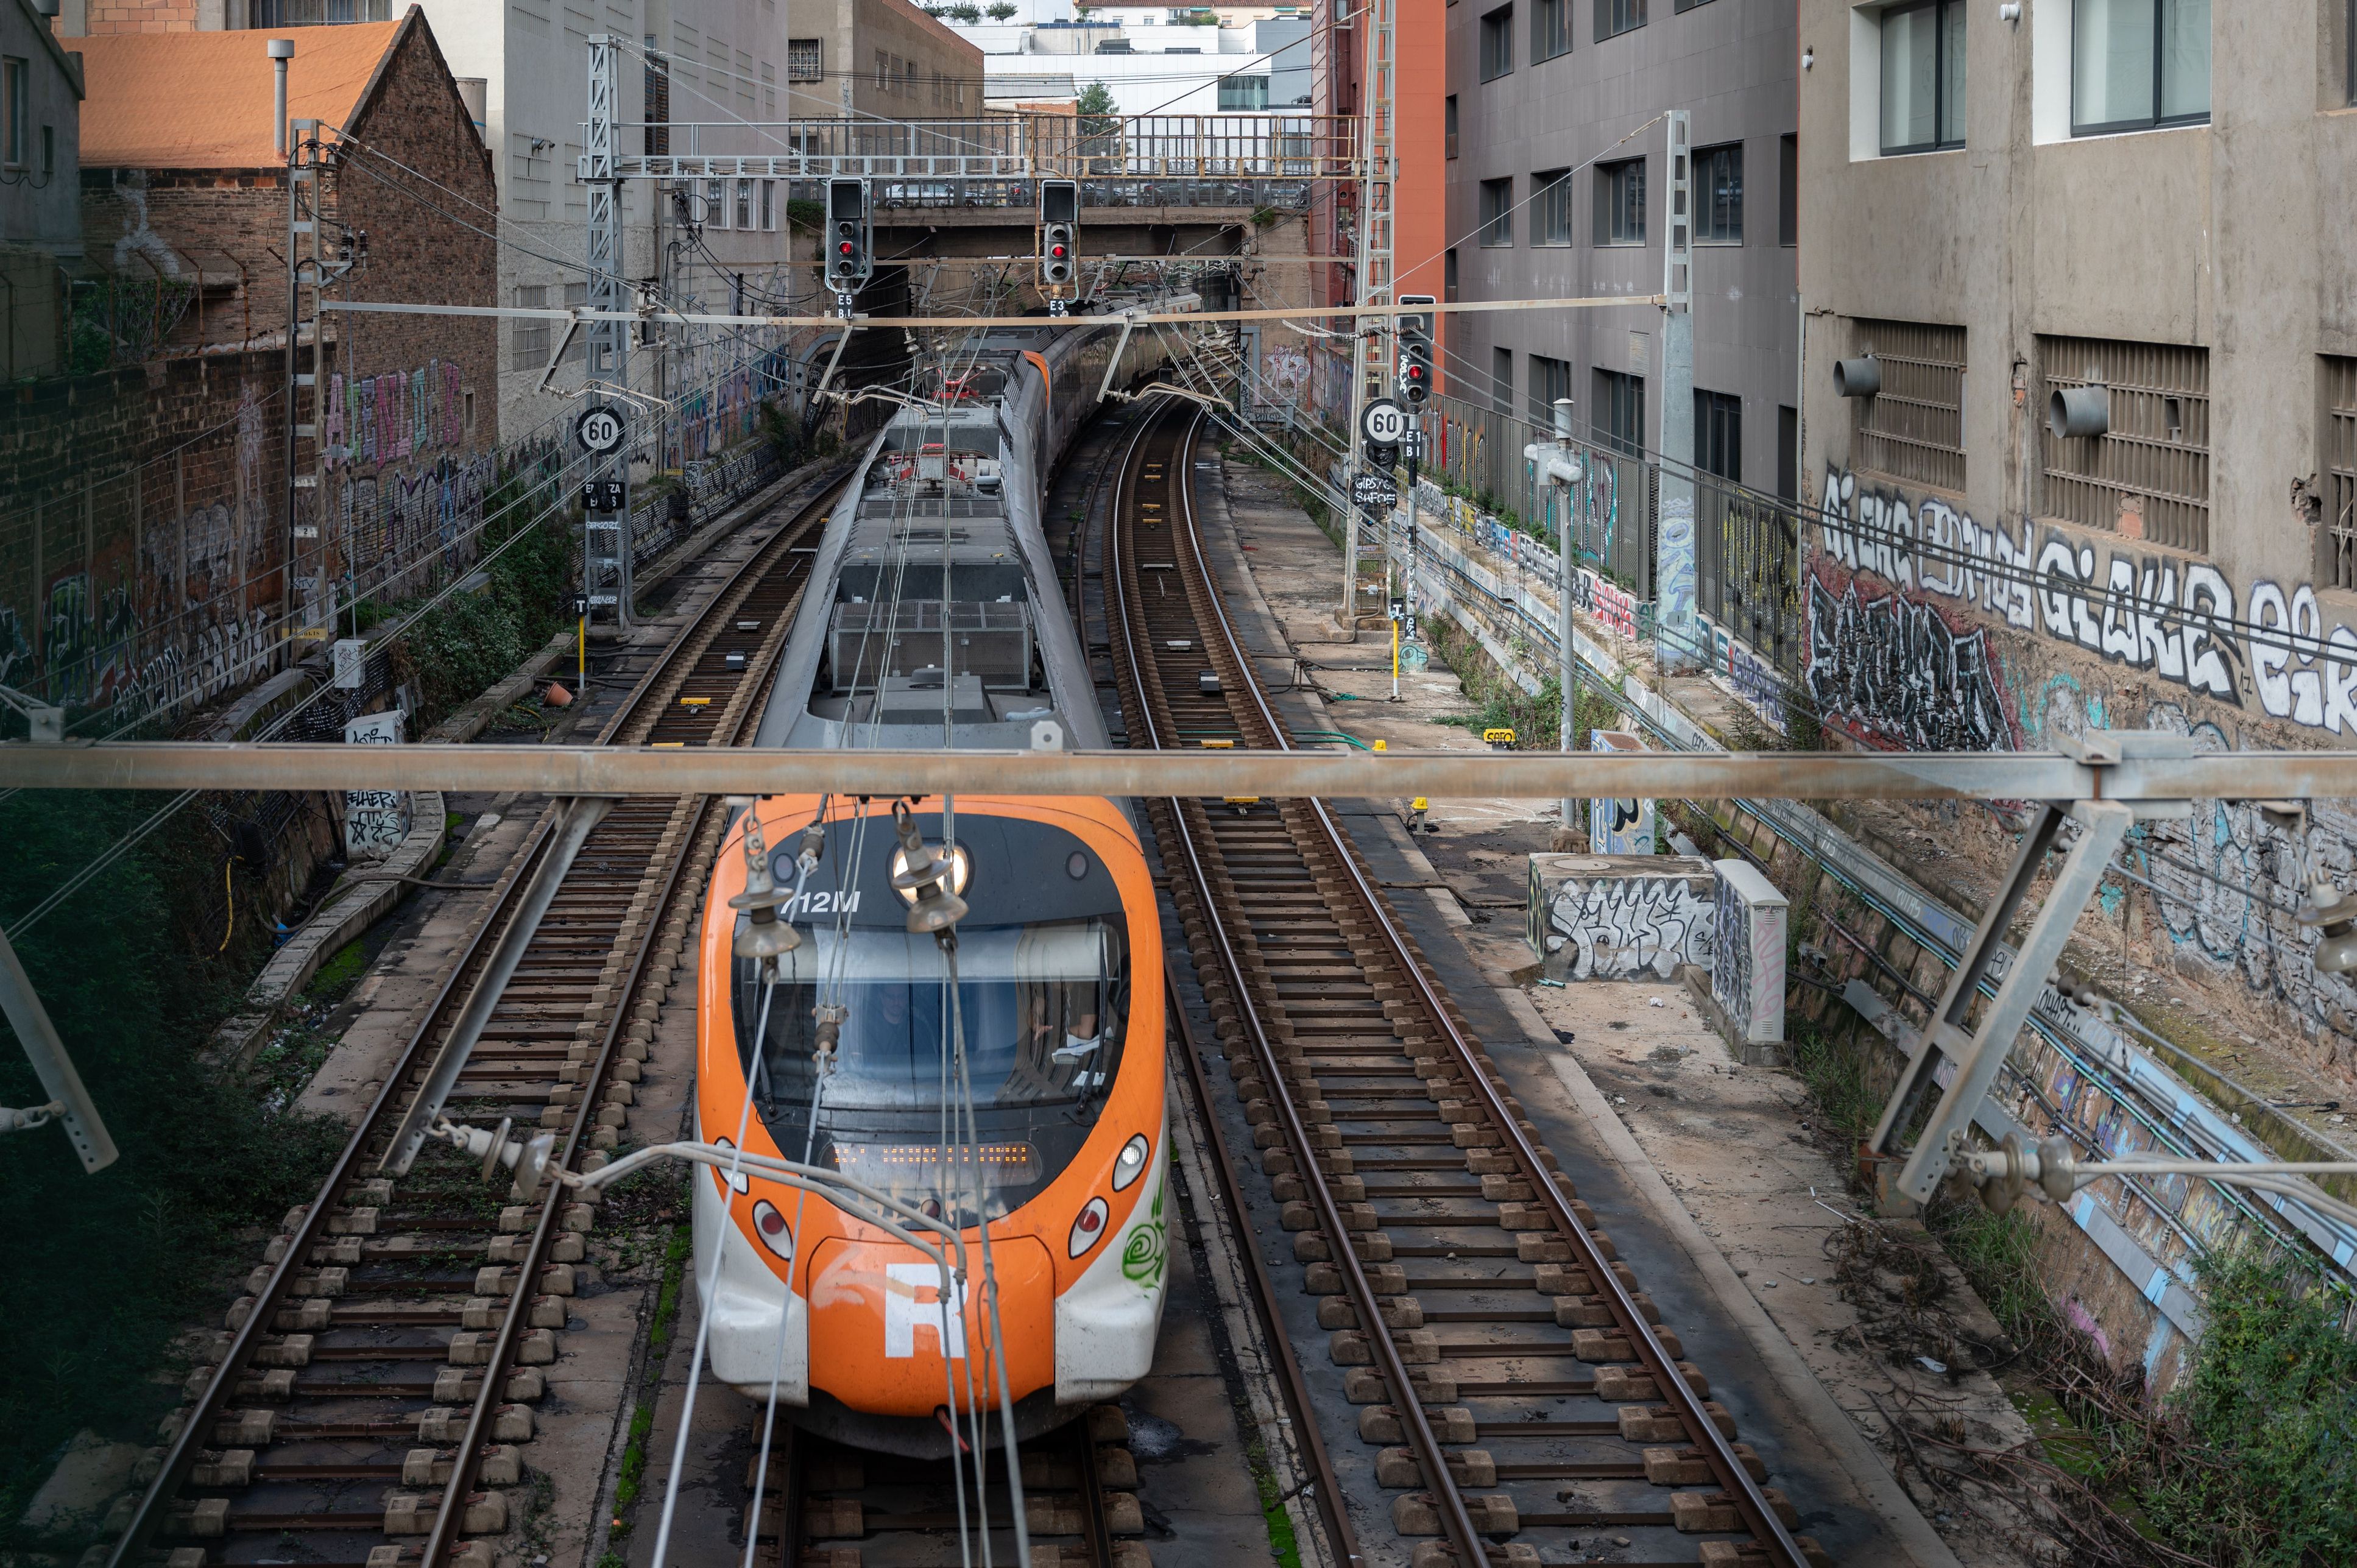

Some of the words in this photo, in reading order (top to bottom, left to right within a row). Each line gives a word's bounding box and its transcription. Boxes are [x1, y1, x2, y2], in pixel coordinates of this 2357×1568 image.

[838, 295, 852, 305] E5
[1050, 300, 1064, 311] E3
[1373, 413, 1397, 433] 60
[588, 422, 612, 441] 60
[1406, 431, 1421, 442] E1
[576, 600, 585, 613] T
[1393, 604, 1402, 616] T
[885, 1262, 970, 1359] R
